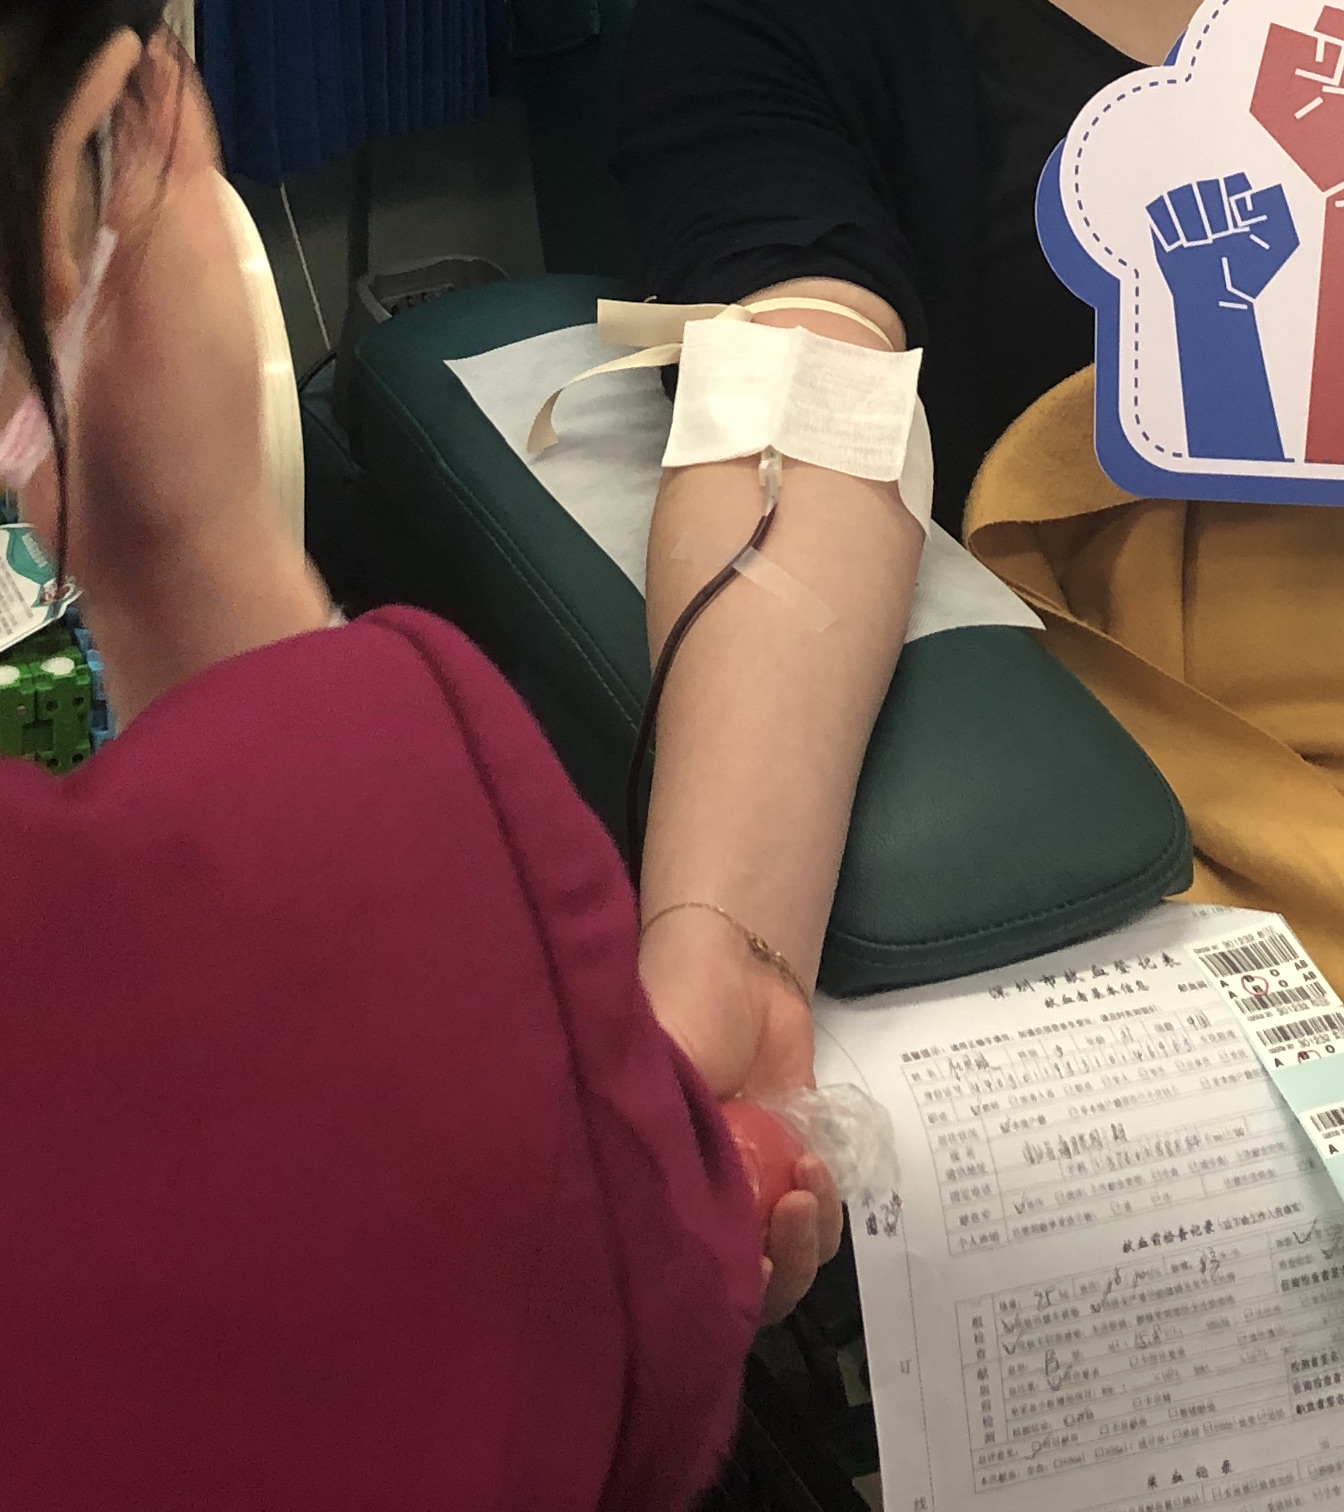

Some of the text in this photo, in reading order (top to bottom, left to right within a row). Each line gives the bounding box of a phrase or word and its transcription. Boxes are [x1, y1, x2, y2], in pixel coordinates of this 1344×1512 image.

[1220, 979, 1229, 988] A
[1269, 968, 1280, 977] O
[1228, 990, 1237, 999] A
[1278, 979, 1289, 988] O
[1274, 1057, 1284, 1068] A
[1325, 1044, 1336, 1054] O
[1328, 1143, 1339, 1154] A
